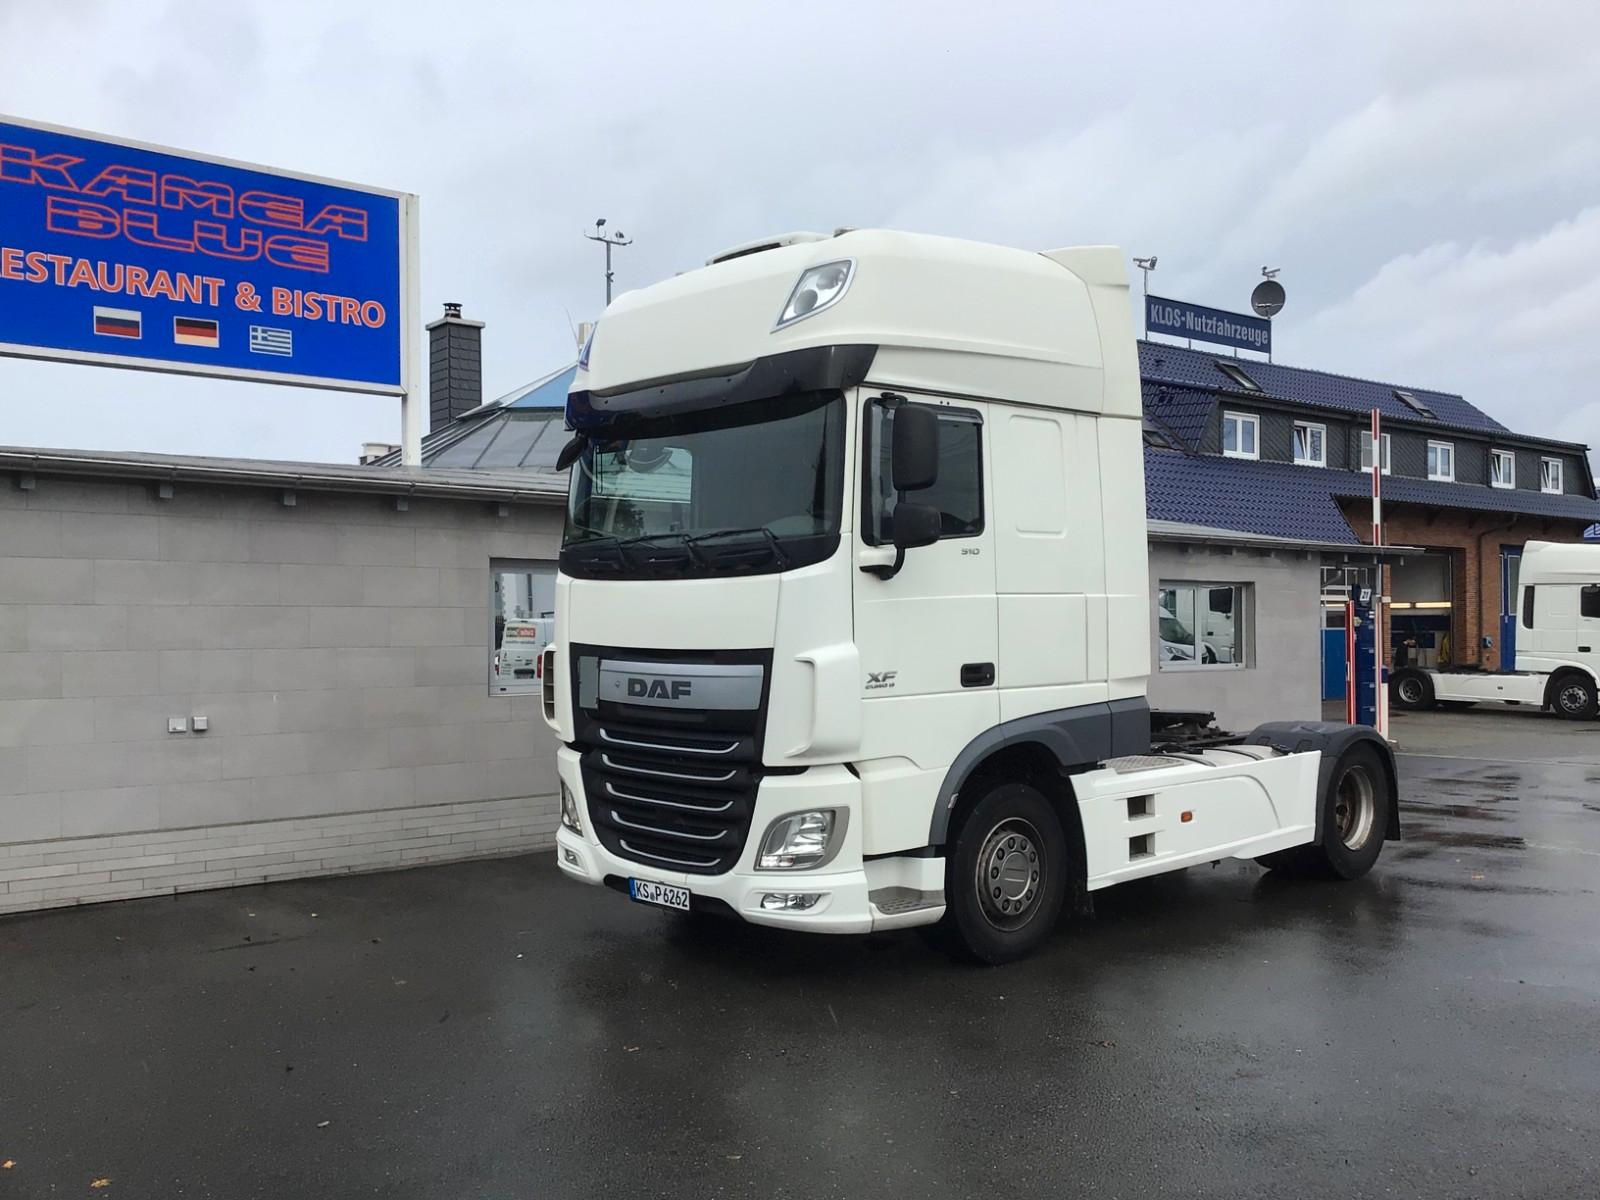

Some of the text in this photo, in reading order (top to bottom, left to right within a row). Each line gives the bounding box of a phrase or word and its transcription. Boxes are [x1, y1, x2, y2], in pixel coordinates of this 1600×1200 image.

[46, 195, 329, 273] BLUE
[0, 247, 386, 329] ESTAURANT & BISTRO
[1151, 304, 1269, 346] KLOS-Nutzfahrzeuge
[627, 678, 692, 700] DAF
[867, 671, 897, 683] XF
